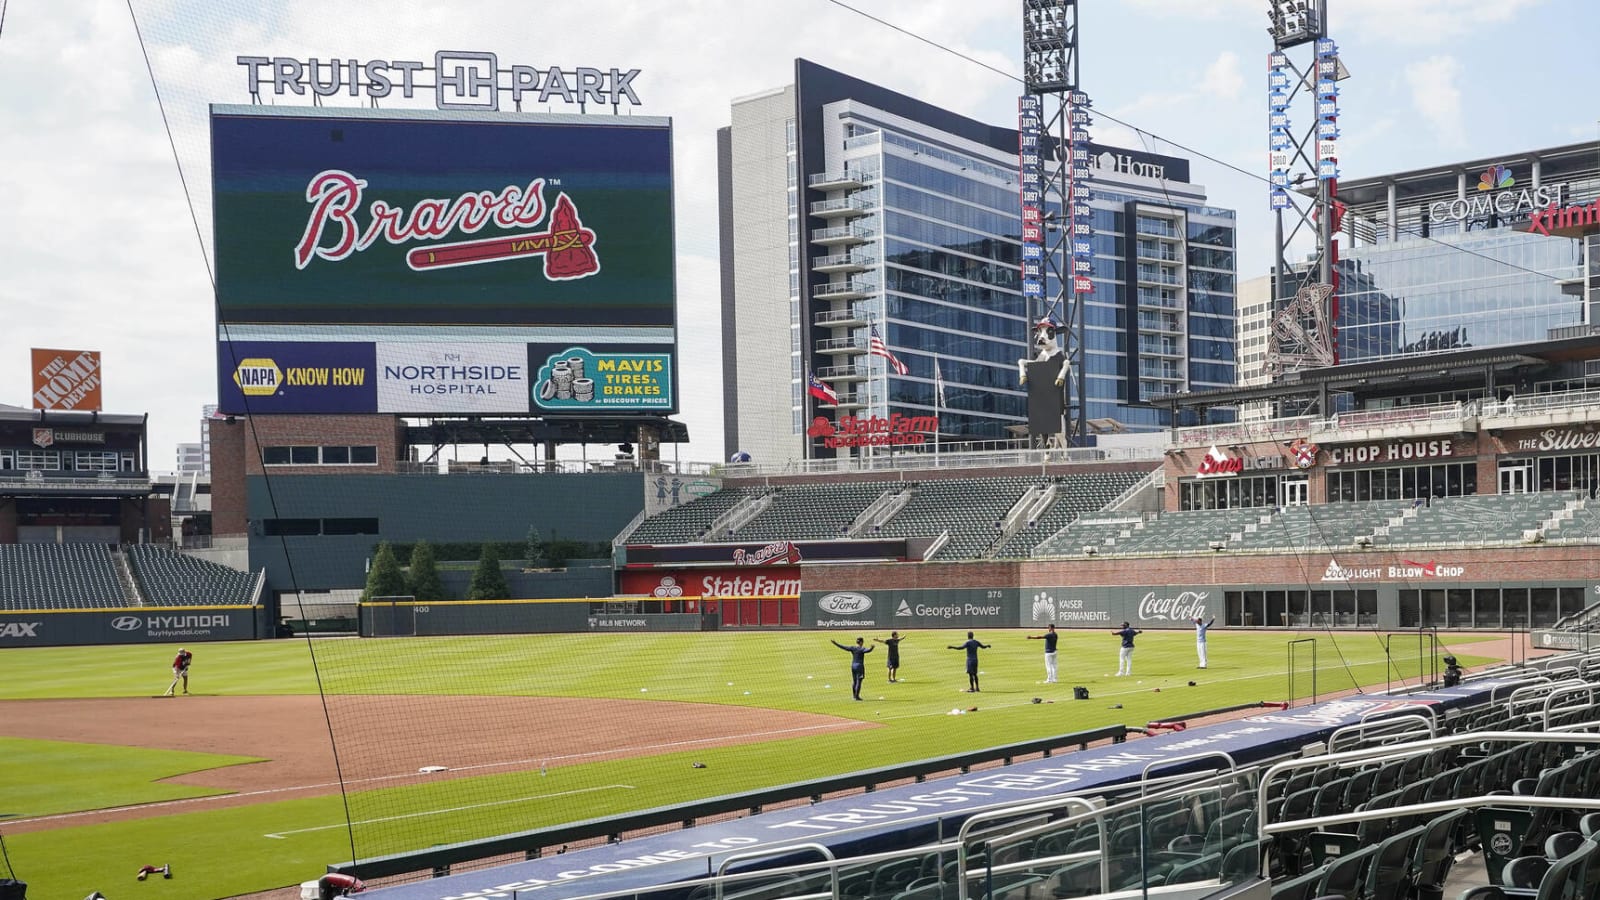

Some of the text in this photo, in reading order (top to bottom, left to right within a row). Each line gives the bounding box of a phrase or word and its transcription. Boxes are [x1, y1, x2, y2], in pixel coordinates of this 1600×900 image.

[236, 56, 642, 106] TRUIST PARK
[1320, 144, 1335, 155] 2012
[1429, 182, 1568, 223] COMCAST
[294, 169, 547, 270] Braves
[39, 355, 68, 380] THE
[385, 365, 521, 380] NORTHSIDE
[597, 359, 663, 372] MAVIS
[33, 350, 101, 410] HOME
[241, 367, 365, 386] NAPA KNOW HOW
[606, 374, 650, 384] TIRES
[60, 373, 101, 410] DEPOT
[410, 384, 497, 394] HOSPITAL
[603, 385, 660, 395] BRAKES
[54, 432, 104, 441] CLUBHOUSE
[824, 434, 925, 448] NEIGHBORHOOD
[1331, 440, 1452, 463] CHOP HOUSE
[1518, 439, 1537, 450] THE
[1198, 453, 1284, 474] Coors LIGHT
[732, 540, 787, 565] Braves
[1354, 568, 1382, 578] LIGHT
[1388, 566, 1424, 578] BELOW
[1436, 565, 1464, 577] CHOP
[988, 590, 1002, 599] 375
[830, 596, 861, 610] Ford
[1059, 600, 1083, 609] KAISER
[916, 604, 1000, 619] Georgia Power
[148, 615, 229, 628] HYUNDAI
[614, 619, 647, 627] NETWORK
[817, 619, 875, 627] BuyFordNow.com
[148, 629, 211, 637] BuyHyundai.com
[691, 835, 760, 850] TO
[767, 787, 993, 830] TRUIST
[1034, 752, 1166, 777] PARK
